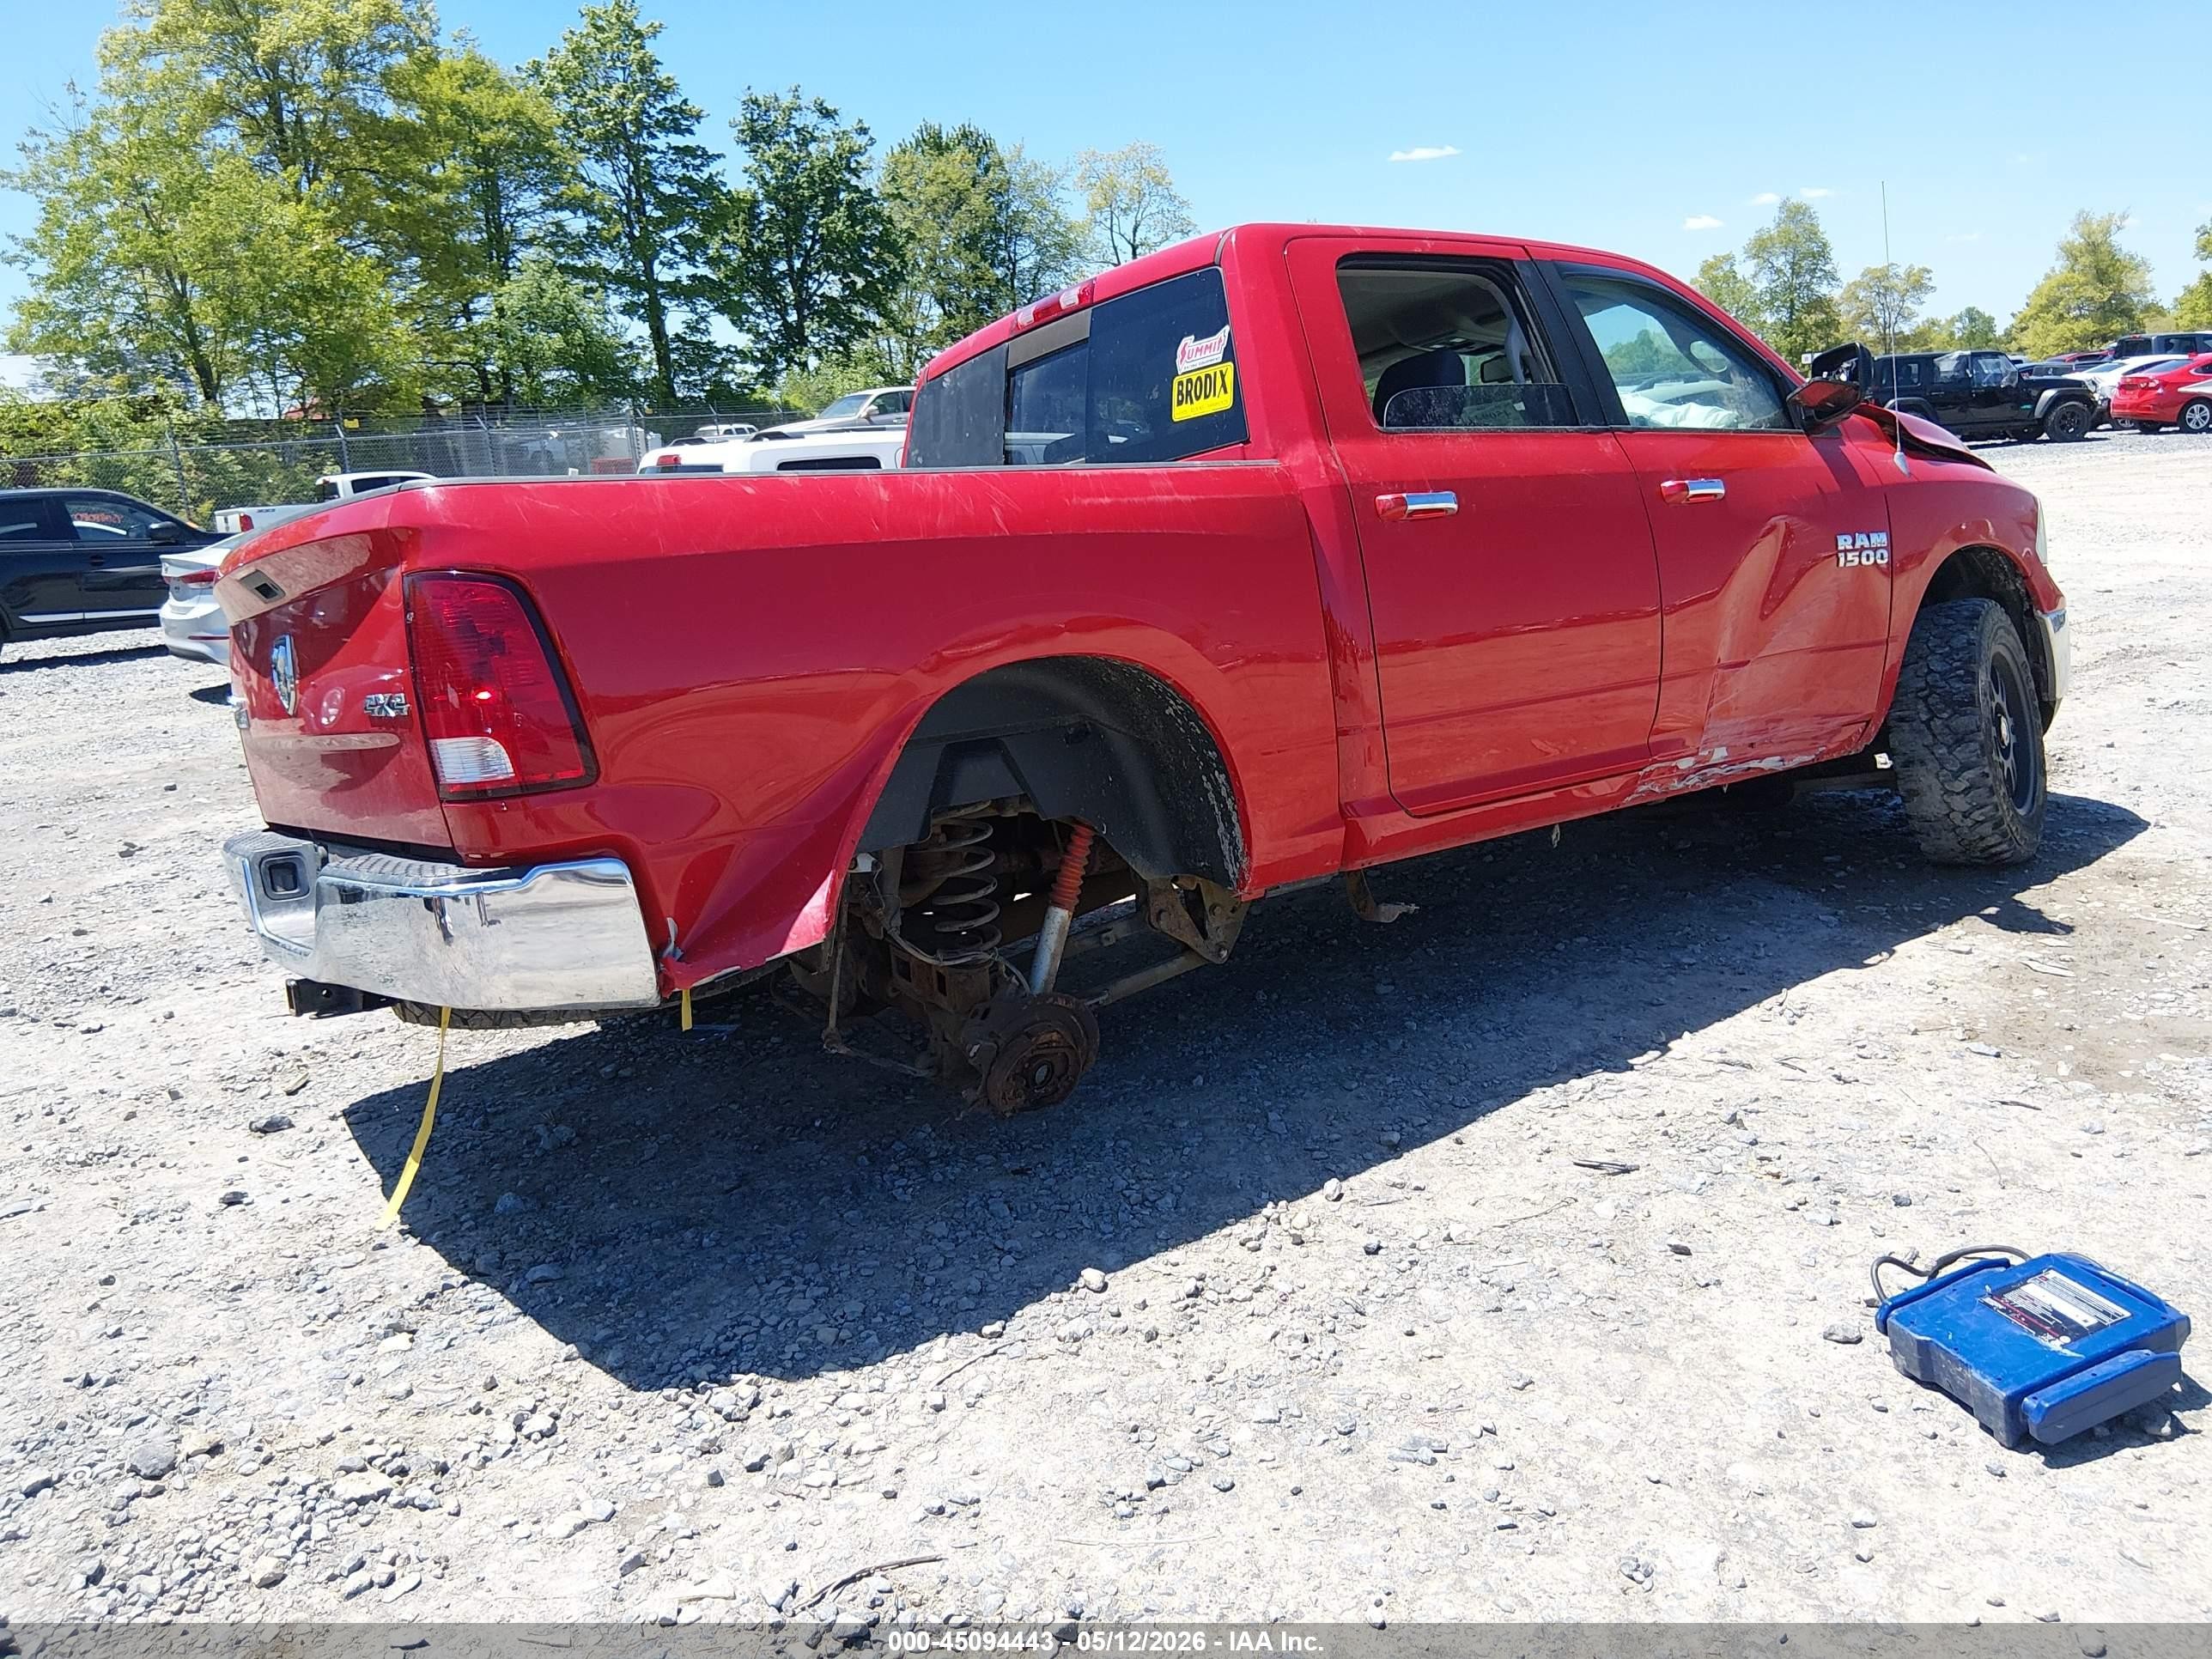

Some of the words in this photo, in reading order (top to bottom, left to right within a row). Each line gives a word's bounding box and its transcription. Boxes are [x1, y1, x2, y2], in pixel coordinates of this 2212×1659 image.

[1179, 335, 1224, 365] SUMMIT
[1176, 368, 1228, 407] BRODIX
[1837, 532, 1887, 550] RAM
[1838, 550, 1888, 568] 1500
